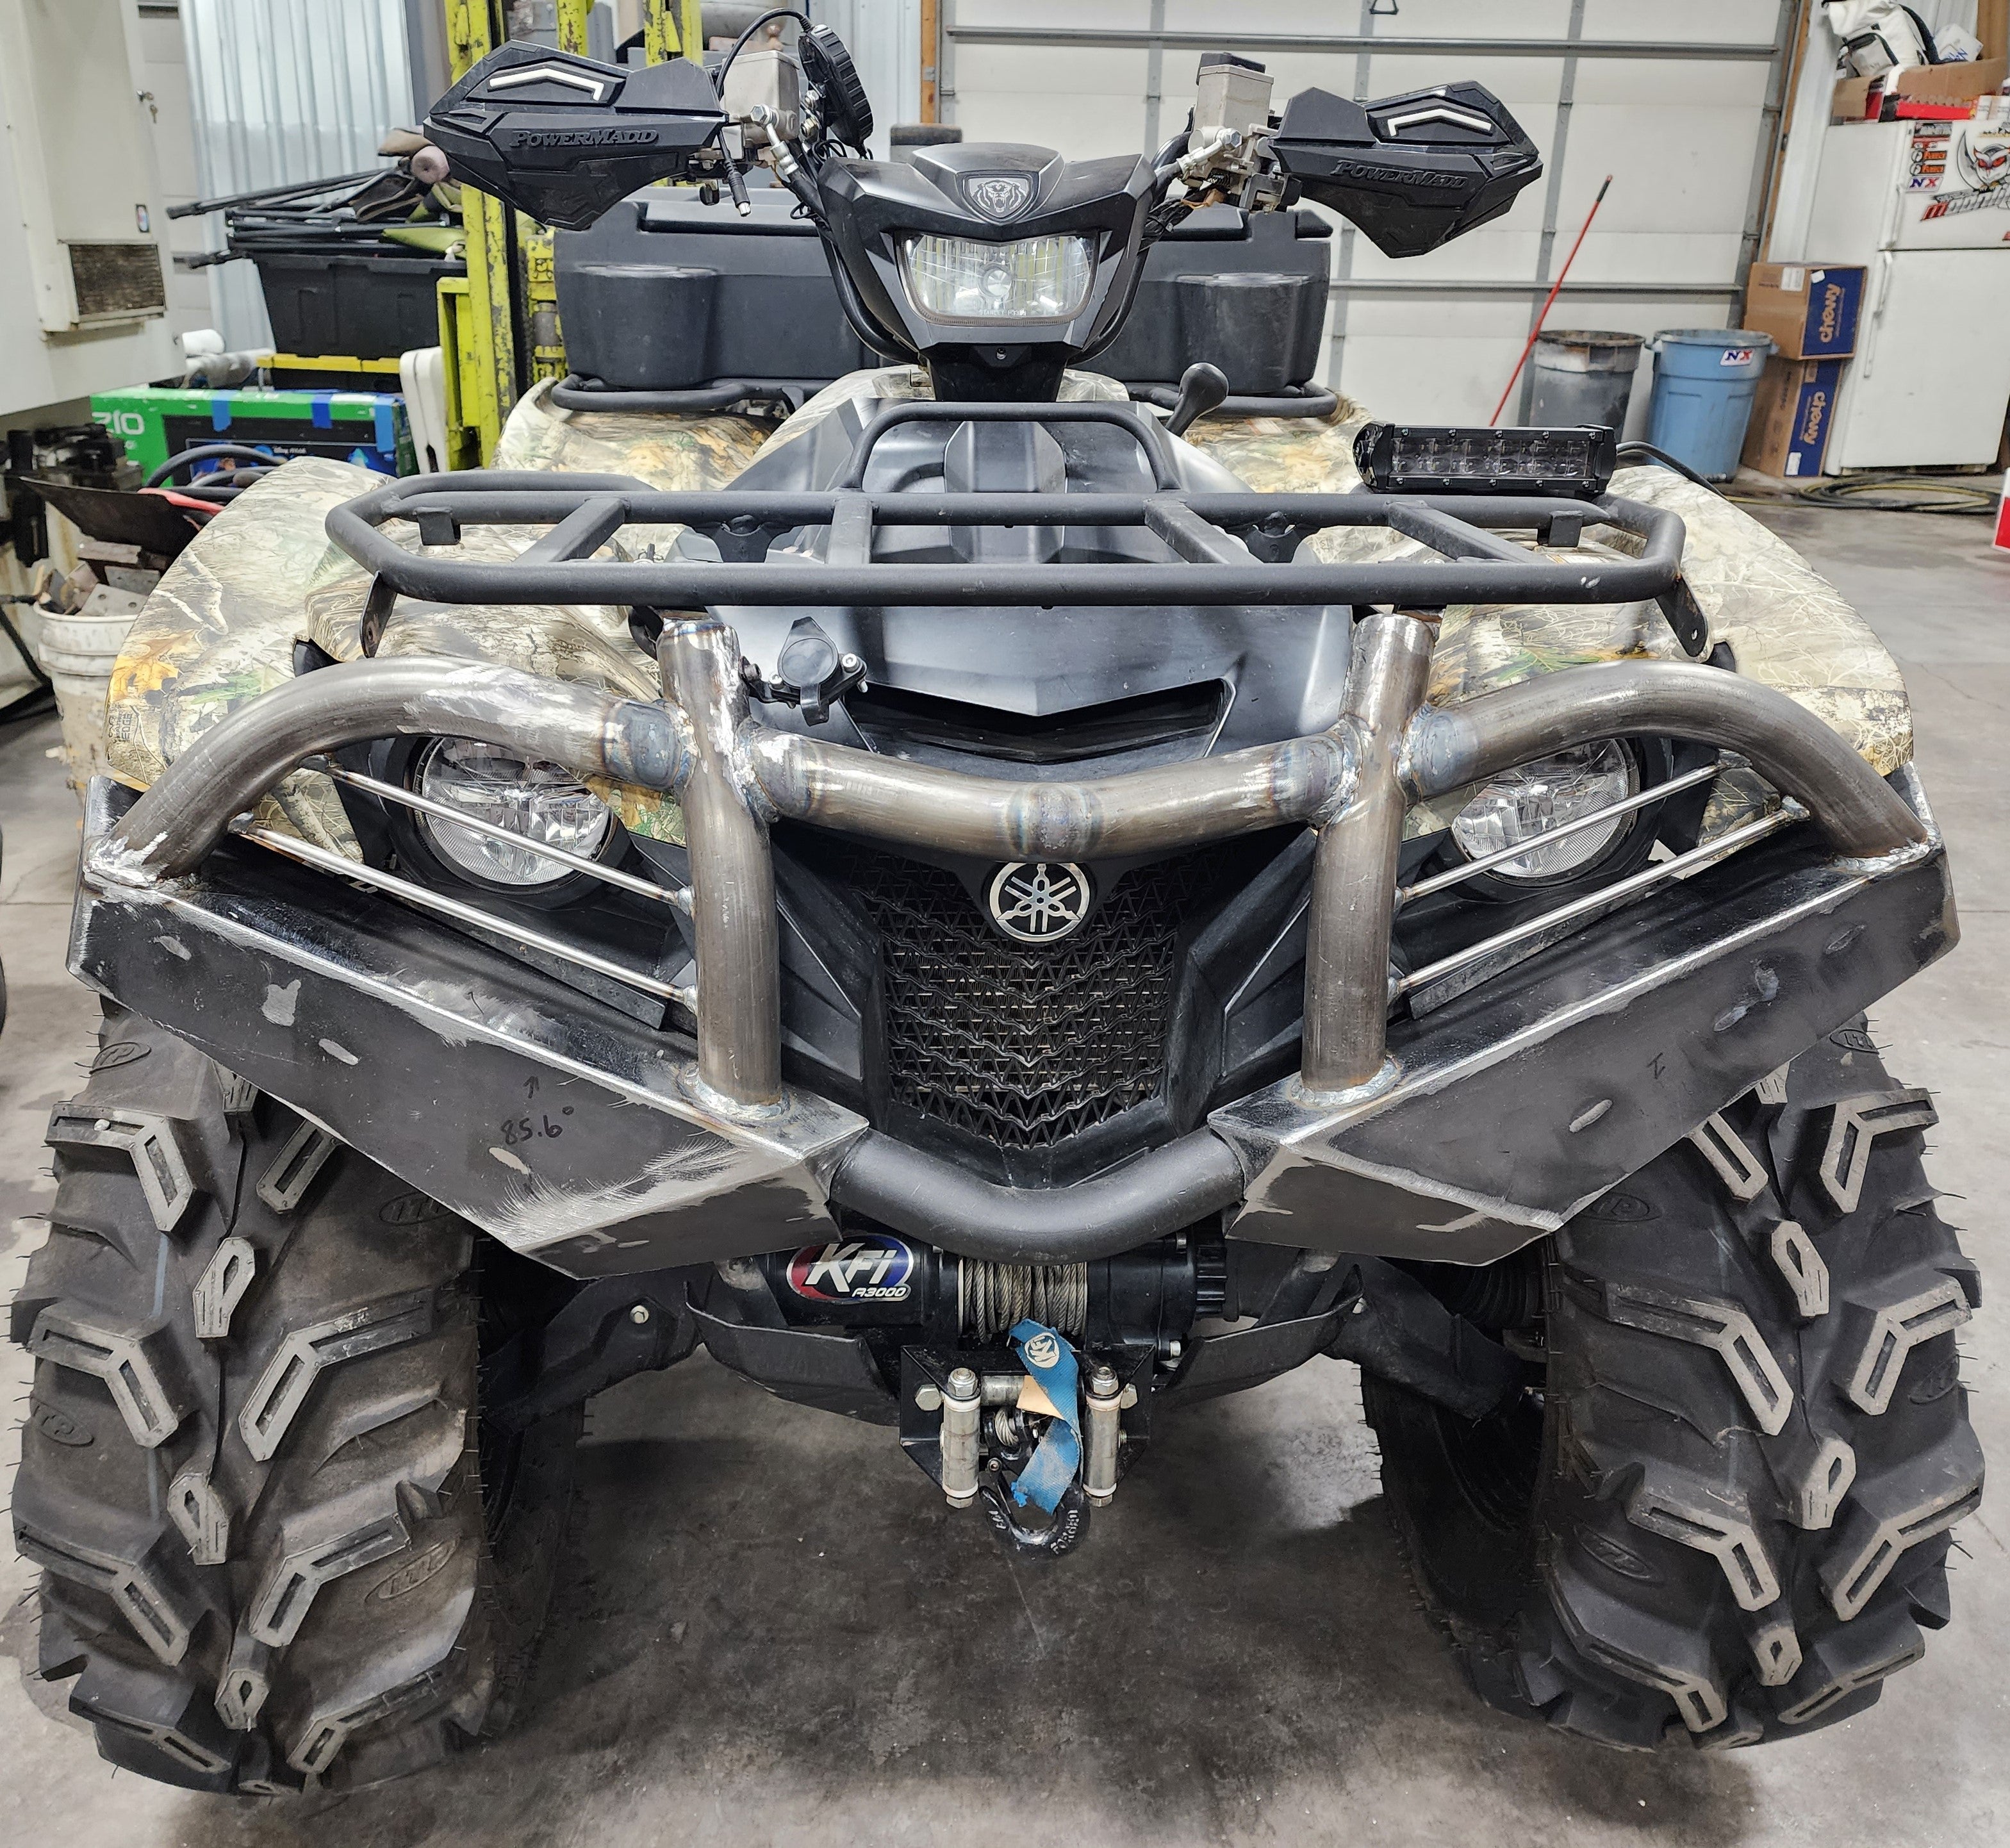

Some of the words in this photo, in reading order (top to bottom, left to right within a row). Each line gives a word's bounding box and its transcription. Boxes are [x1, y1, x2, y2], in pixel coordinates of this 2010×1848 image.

[1909, 177, 1940, 188] NX
[1818, 283, 1842, 343] chewy
[1725, 351, 1752, 361] NX
[1803, 391, 1826, 445] chewy
[122, 713, 133, 739] EDGE
[852, 1287, 907, 1298] A3000
